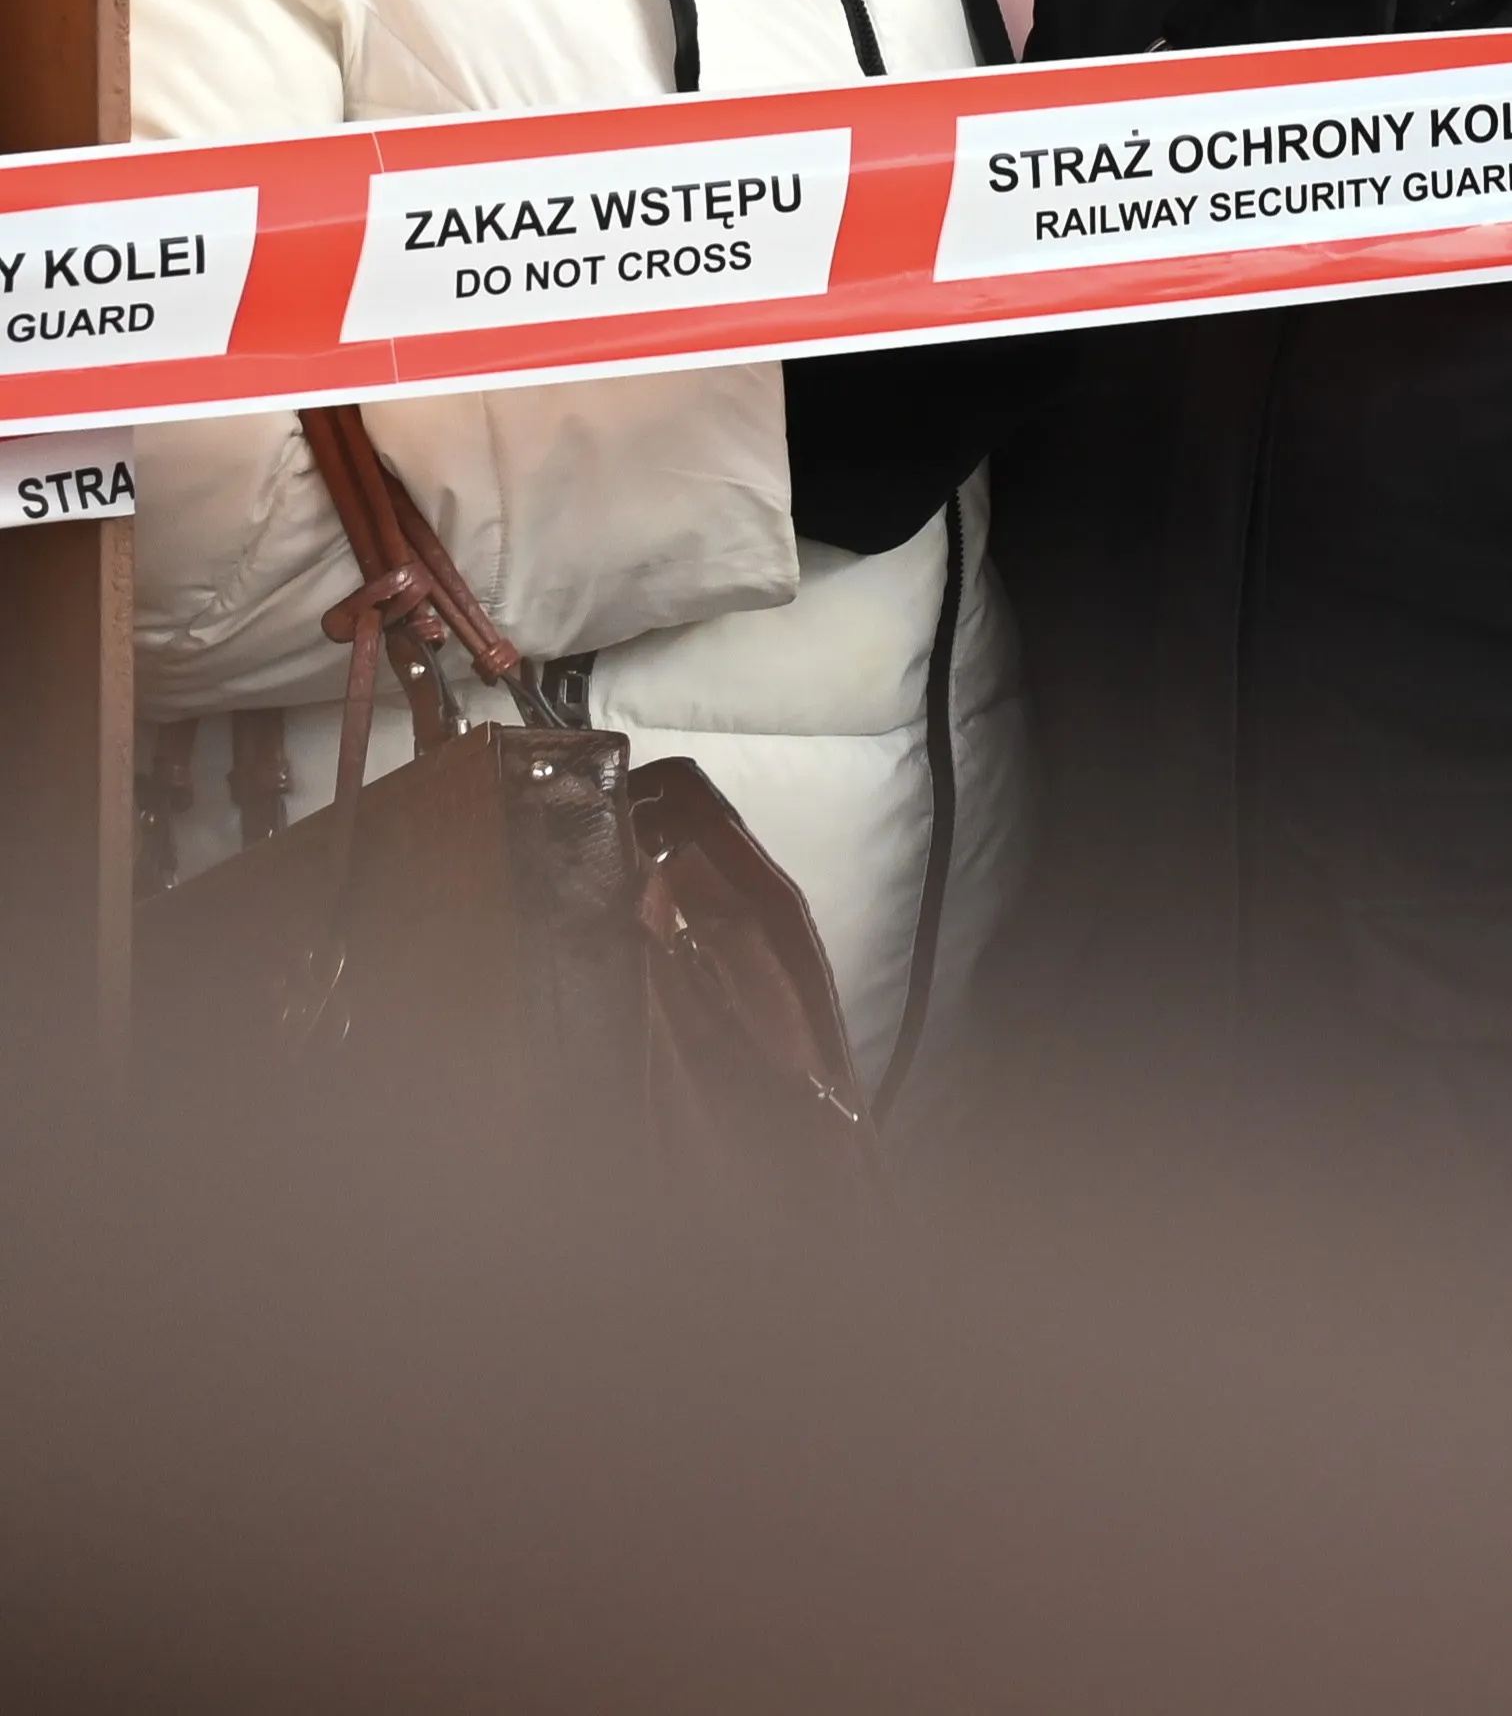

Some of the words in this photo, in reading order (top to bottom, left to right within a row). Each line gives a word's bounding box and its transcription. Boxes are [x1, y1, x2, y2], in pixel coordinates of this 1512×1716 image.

[988, 129, 1153, 193] STRAŻ
[1168, 111, 1415, 174] OCHRONY
[404, 196, 577, 251] ZAKAZ
[590, 173, 802, 231] WSTĘPU
[1036, 195, 1199, 241] RAILWAY
[1209, 175, 1392, 222] SECURITY
[44, 234, 205, 290] KOLEI
[455, 265, 512, 299] DO
[525, 255, 606, 292] NOT
[617, 240, 752, 282] CROSS
[6, 302, 155, 343] GUARD
